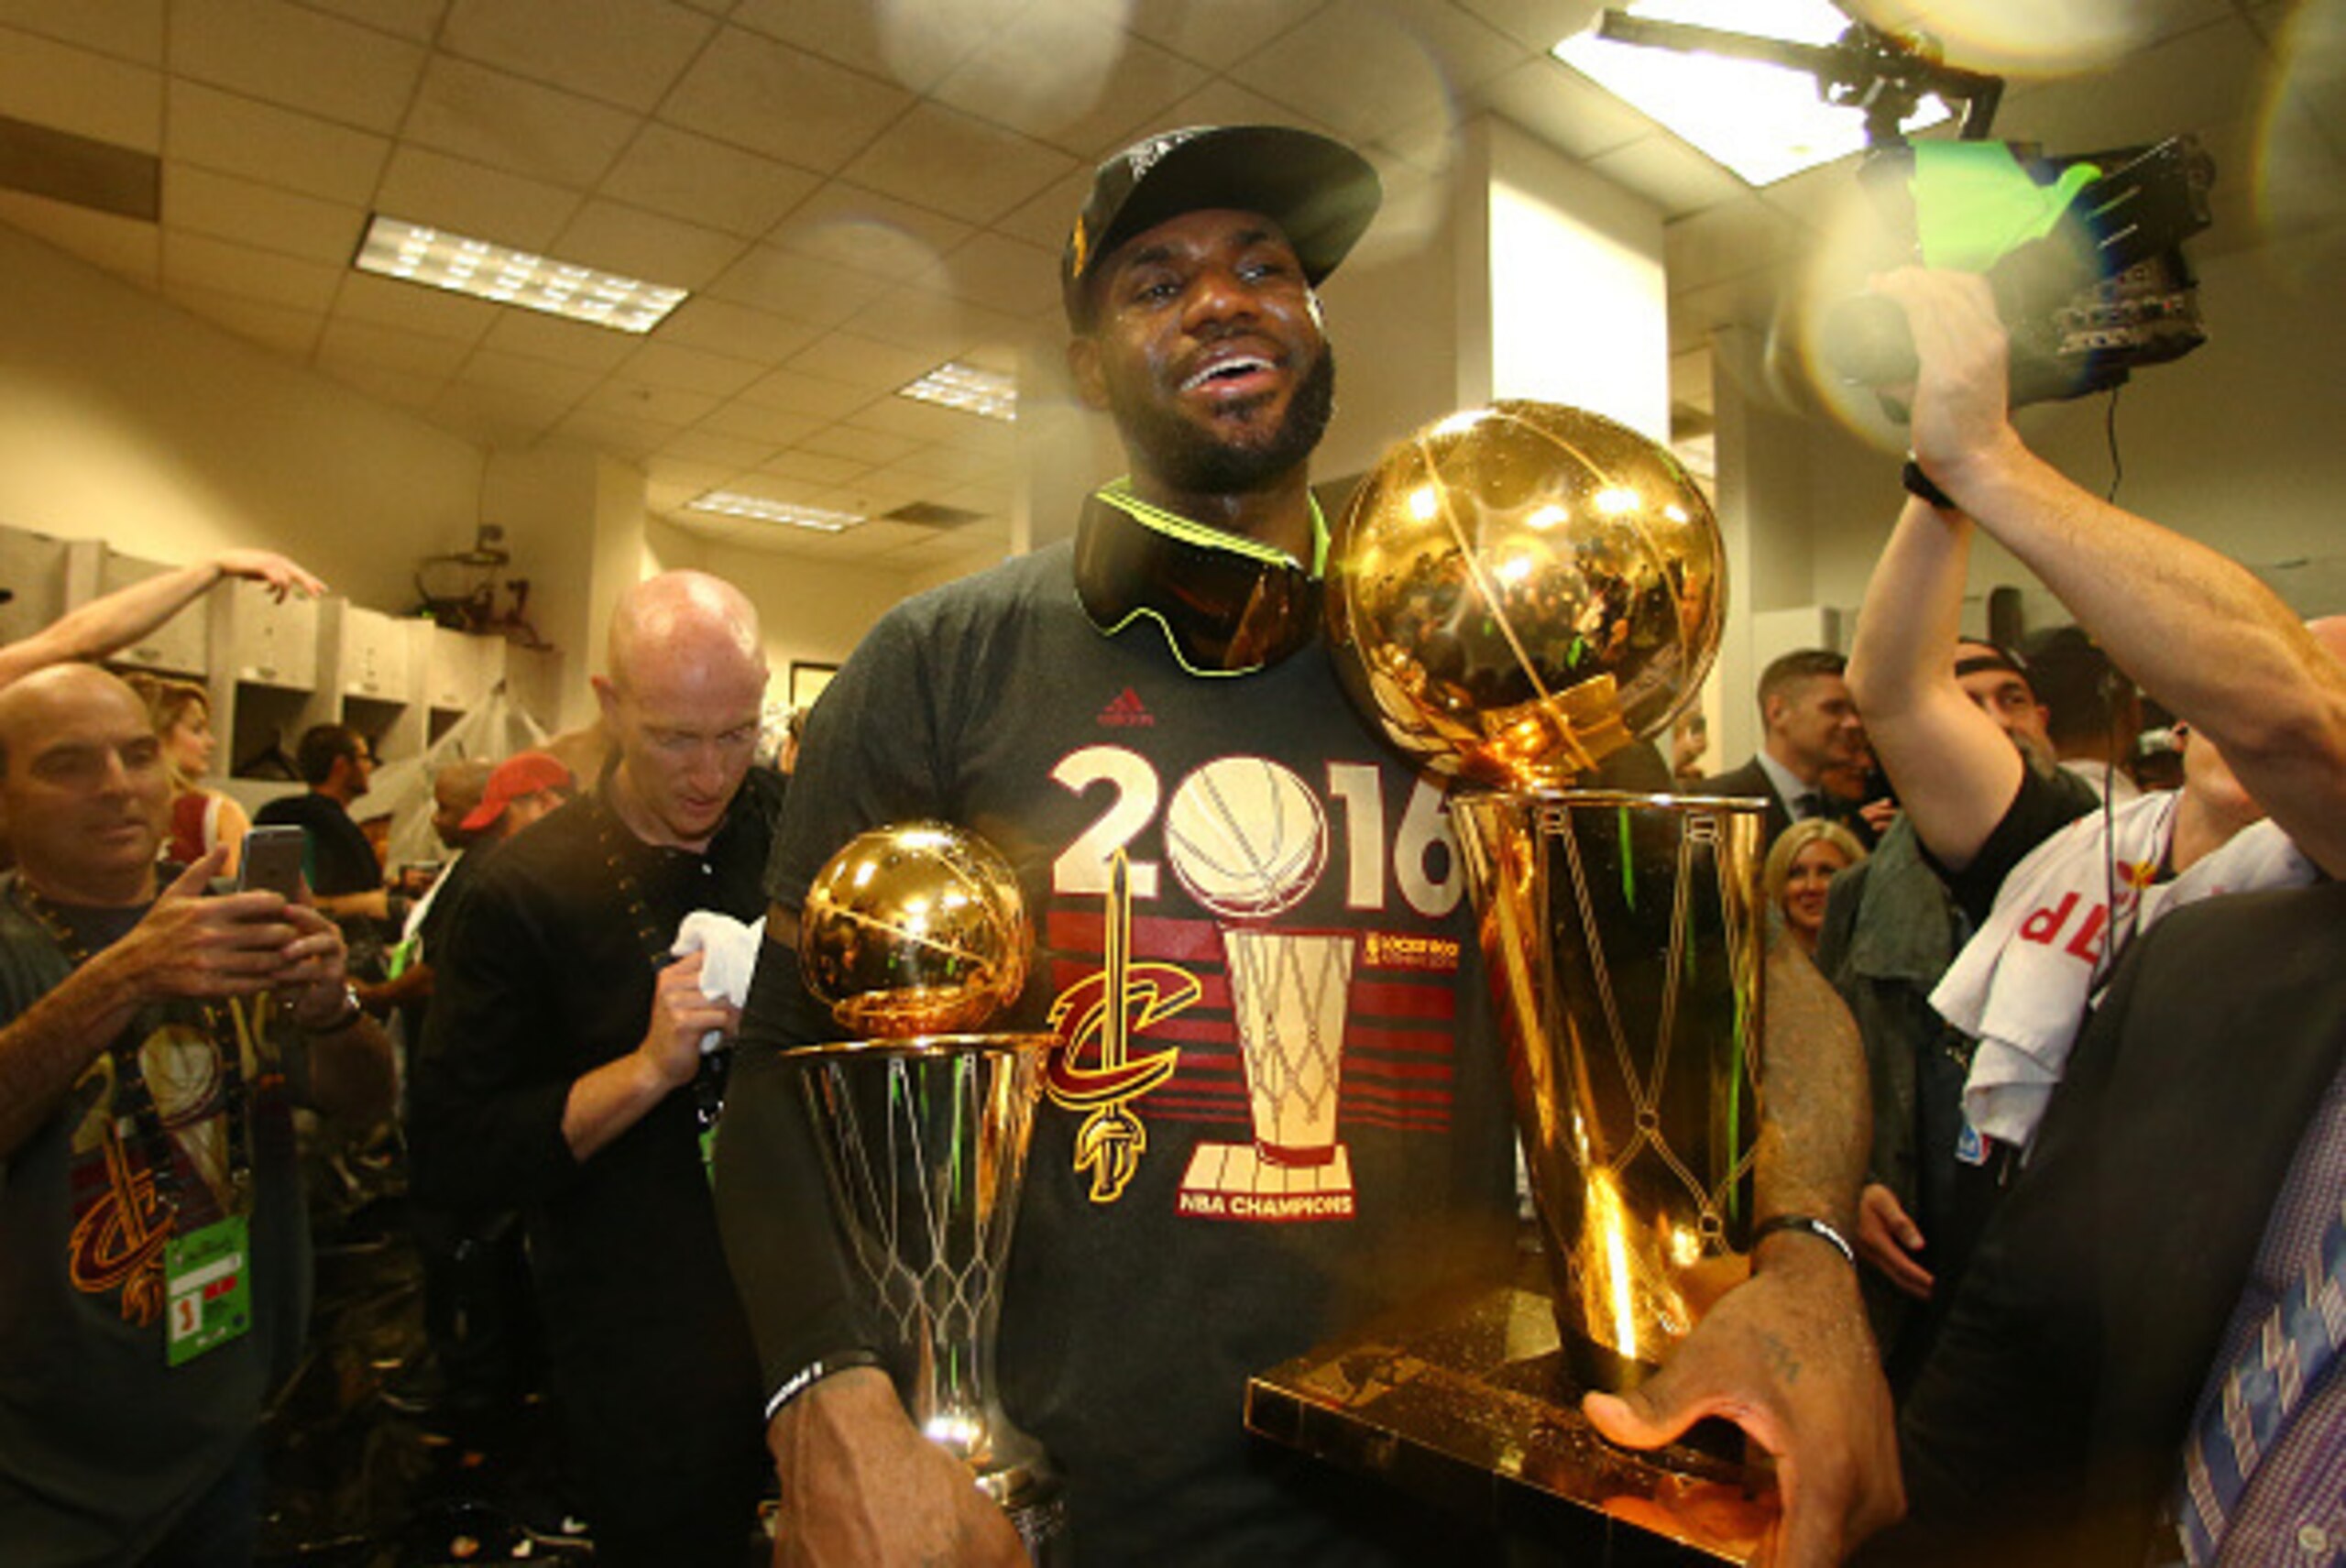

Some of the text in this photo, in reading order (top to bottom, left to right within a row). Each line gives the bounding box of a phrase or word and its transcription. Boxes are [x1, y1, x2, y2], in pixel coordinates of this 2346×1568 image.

[1047, 741, 1466, 919] 2016
[1179, 1192, 1353, 1217] NBA CHAMPIONS
